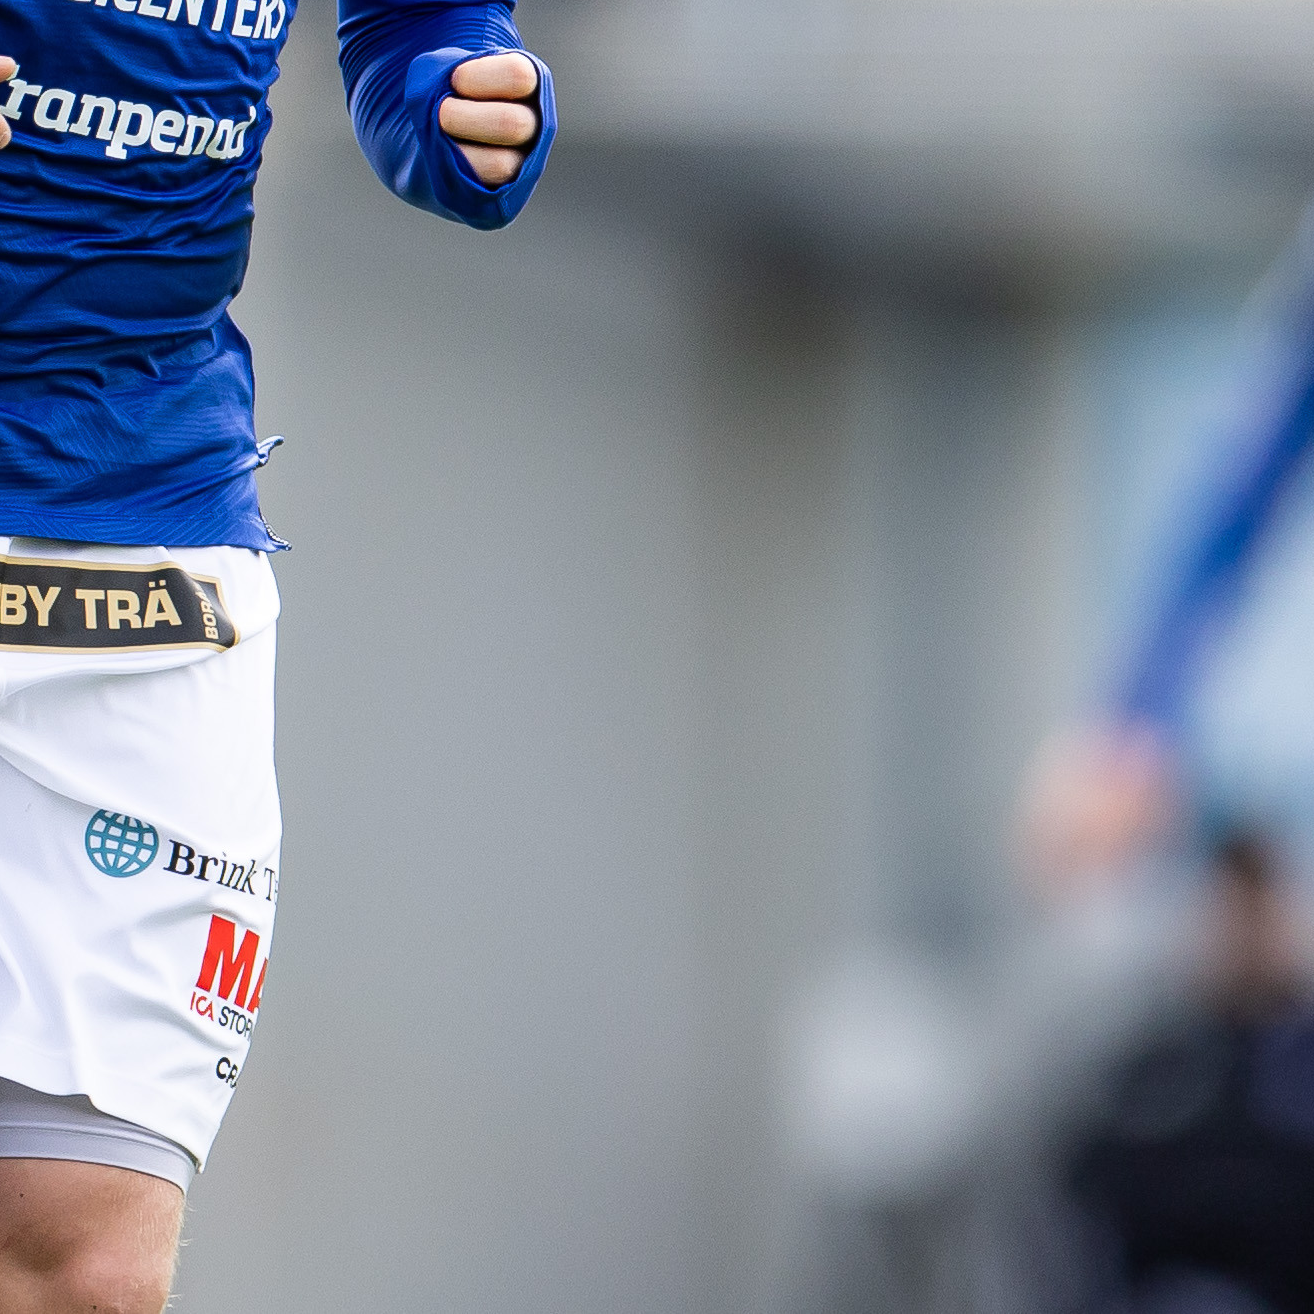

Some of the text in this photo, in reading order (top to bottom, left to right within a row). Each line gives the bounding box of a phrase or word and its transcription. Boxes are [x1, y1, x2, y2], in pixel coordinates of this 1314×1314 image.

[75, 579, 182, 630] TRÄ
[163, 838, 256, 895] Brink
[190, 991, 214, 1022] ICA
